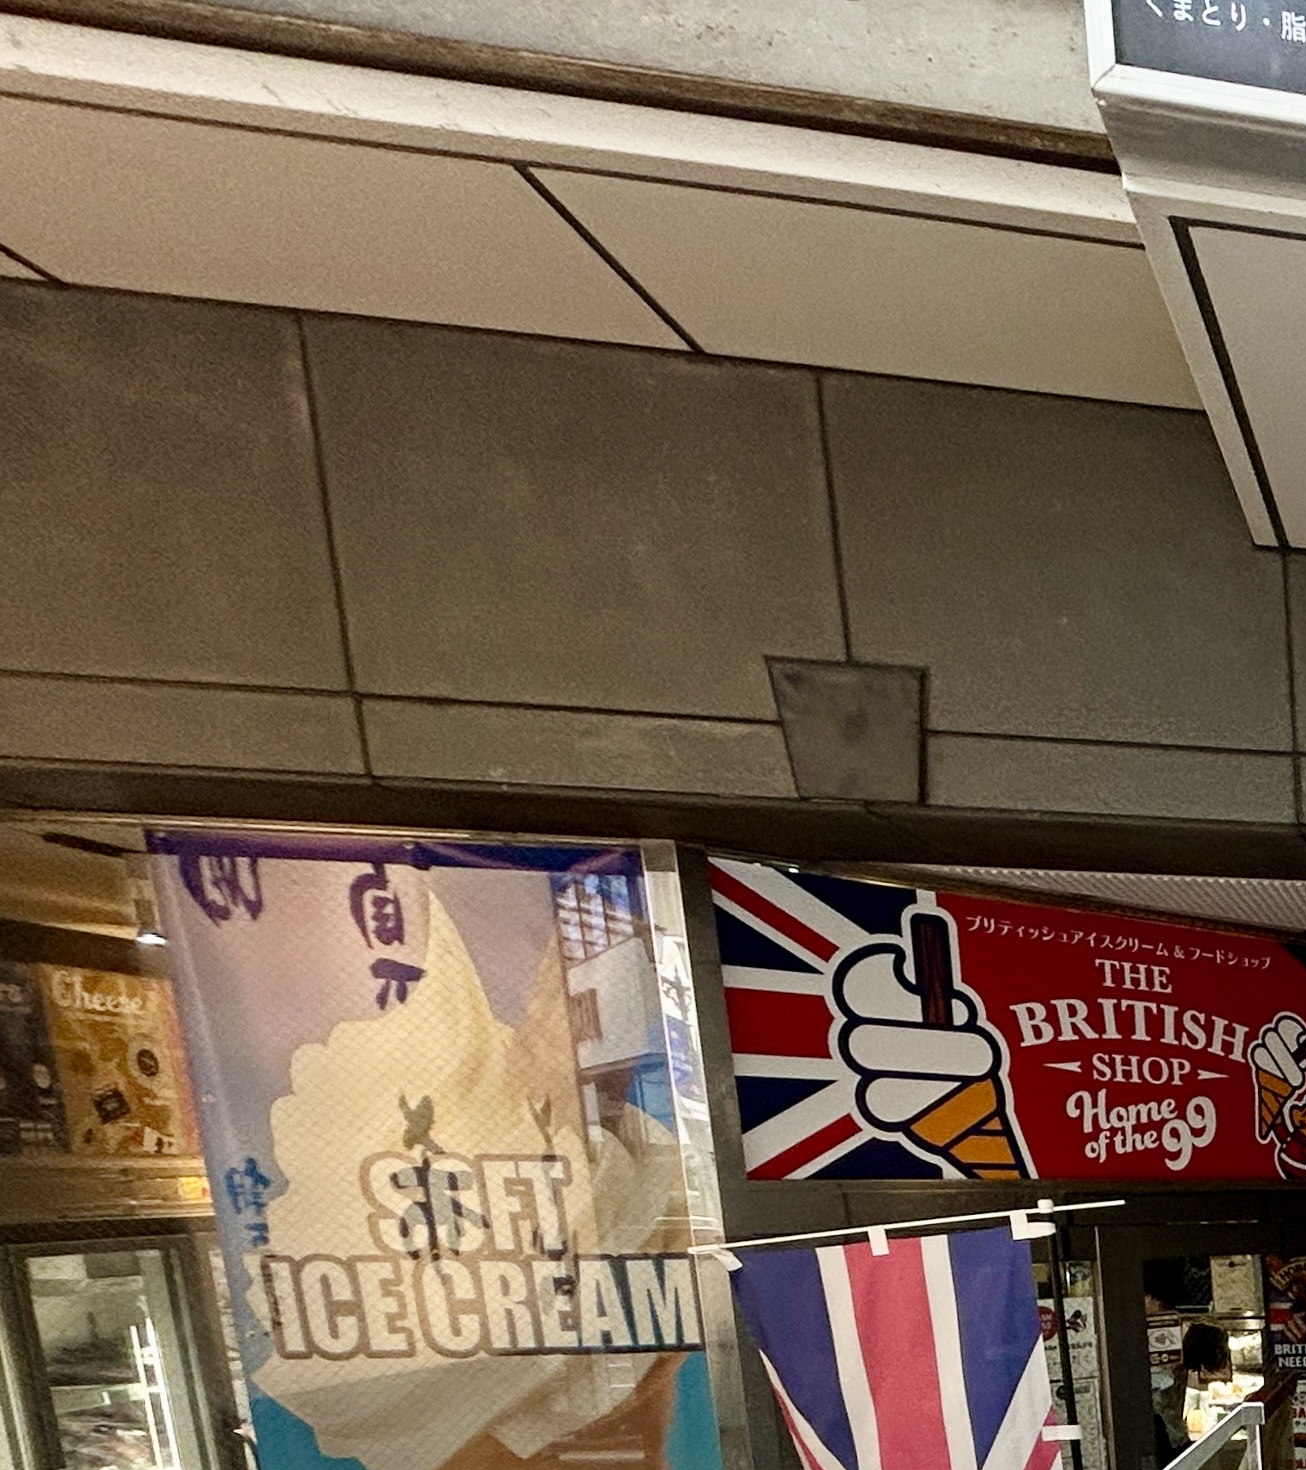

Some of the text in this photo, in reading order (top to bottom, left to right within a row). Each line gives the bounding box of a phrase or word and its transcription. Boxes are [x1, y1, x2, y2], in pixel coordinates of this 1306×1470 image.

[965, 914, 1169, 958] ブリティッシュアイスクリーム
[1094, 957, 1173, 994] THE
[1009, 997, 1250, 1063] BRITISH
[1091, 1052, 1192, 1086] SHOP
[1065, 1088, 1178, 1134] Home
[1084, 1130, 1111, 1163] of
[1112, 1123, 1161, 1155] the
[262, 1253, 700, 1361] ICE CREAM
